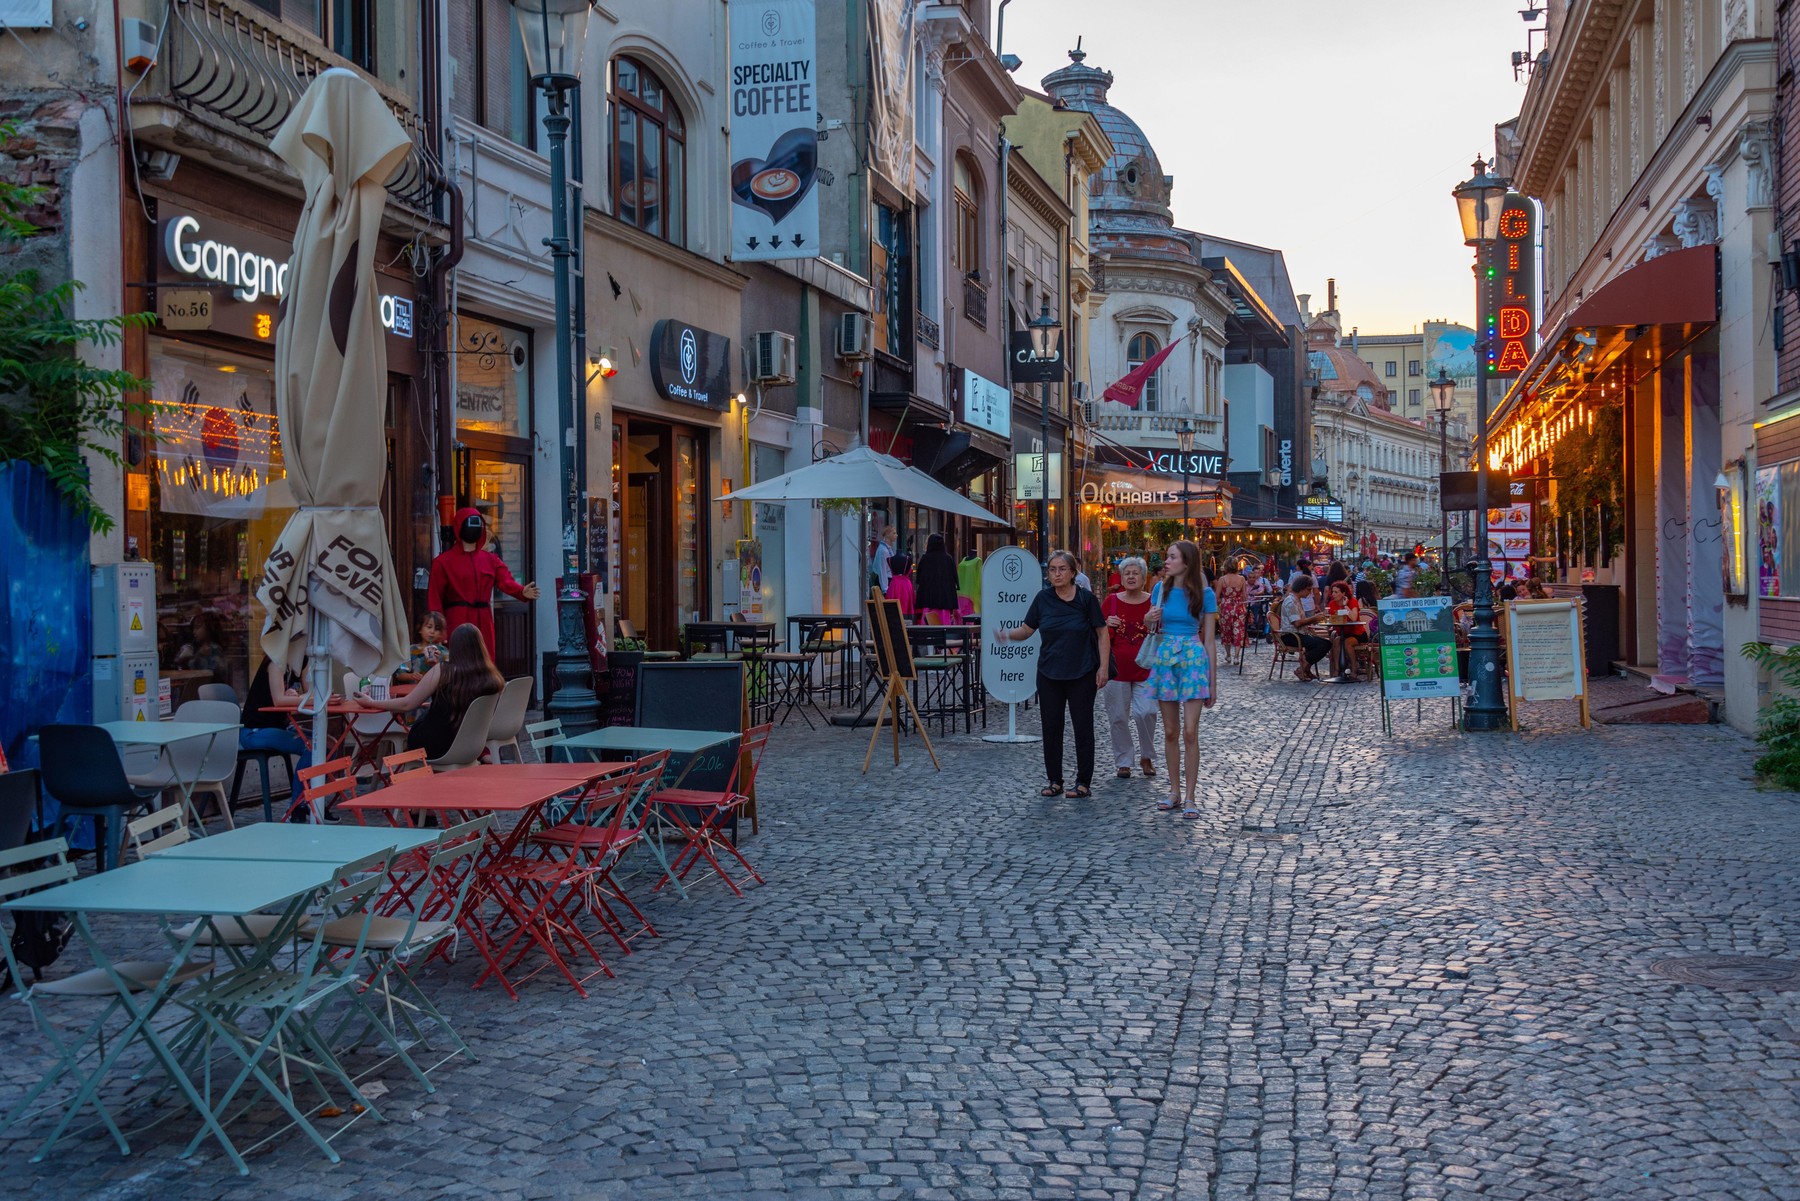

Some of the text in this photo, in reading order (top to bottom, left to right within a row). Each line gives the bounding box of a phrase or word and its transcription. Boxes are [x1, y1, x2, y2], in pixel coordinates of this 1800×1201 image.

[738, 38, 805, 50] Coffee & Travel
[733, 60, 810, 86] SPECIALTY
[733, 83, 811, 117] COFFEE
[1498, 208, 1530, 371] GILDA
[669, 383, 709, 402] Coffee & Travel
[1279, 440, 1292, 487] diverta
[1080, 482, 1179, 504] Old HABITS
[1116, 506, 1164, 519] Old HABITS
[997, 591, 1027, 603] Store
[1391, 598, 1438, 608] TOURIST INFO POINT
[990, 643, 1034, 659] luggage
[1000, 669, 1025, 682] here
